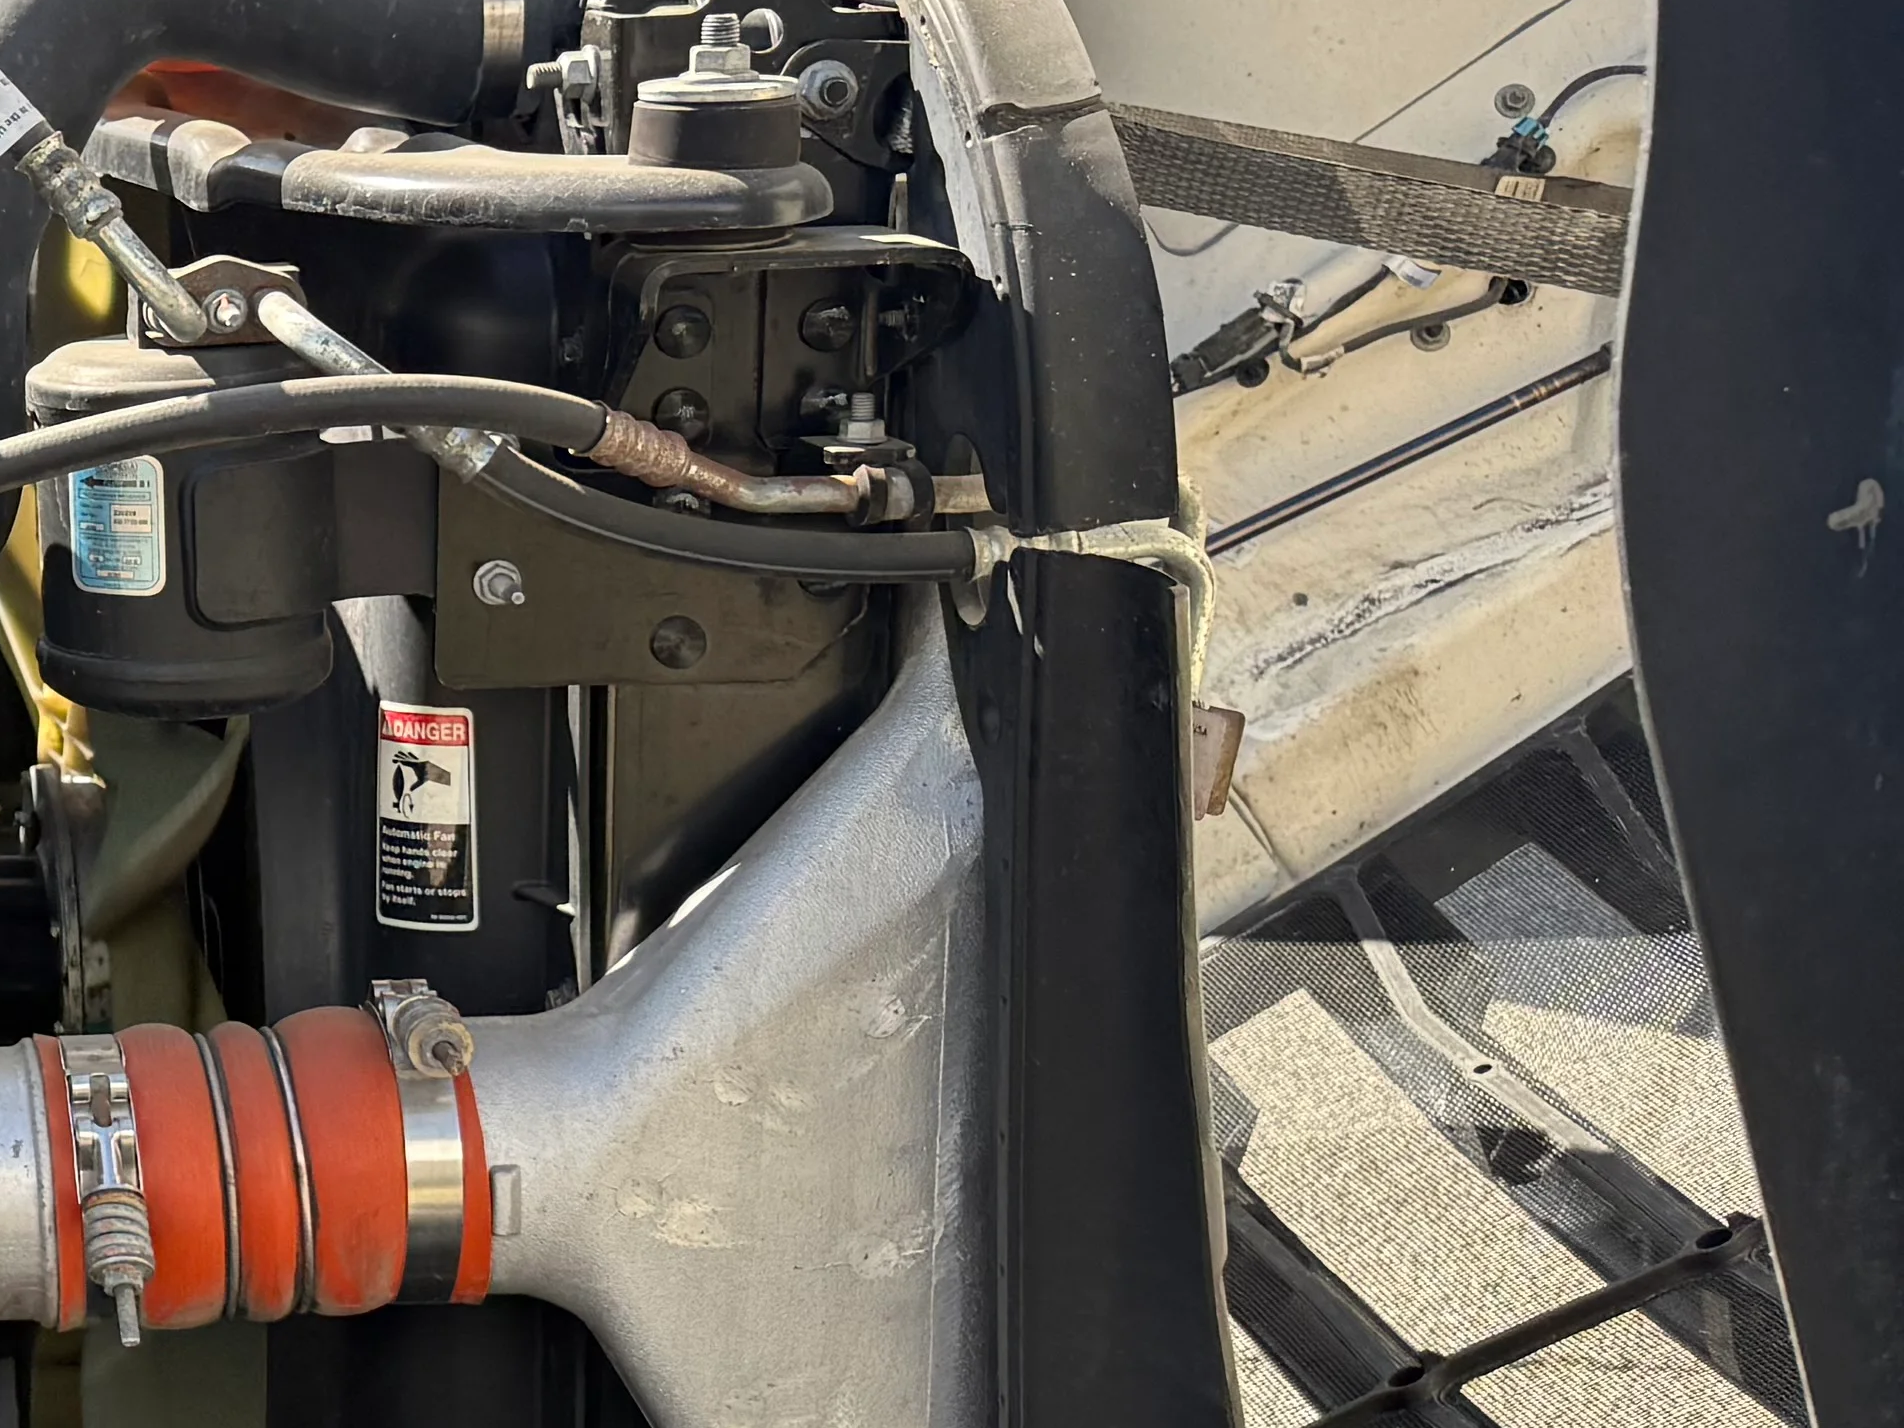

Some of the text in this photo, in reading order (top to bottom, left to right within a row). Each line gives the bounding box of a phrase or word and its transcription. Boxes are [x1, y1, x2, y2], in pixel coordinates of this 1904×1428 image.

[392, 719, 466, 741] DANGER
[433, 831, 456, 842] Fan
[432, 848, 458, 859] clear
